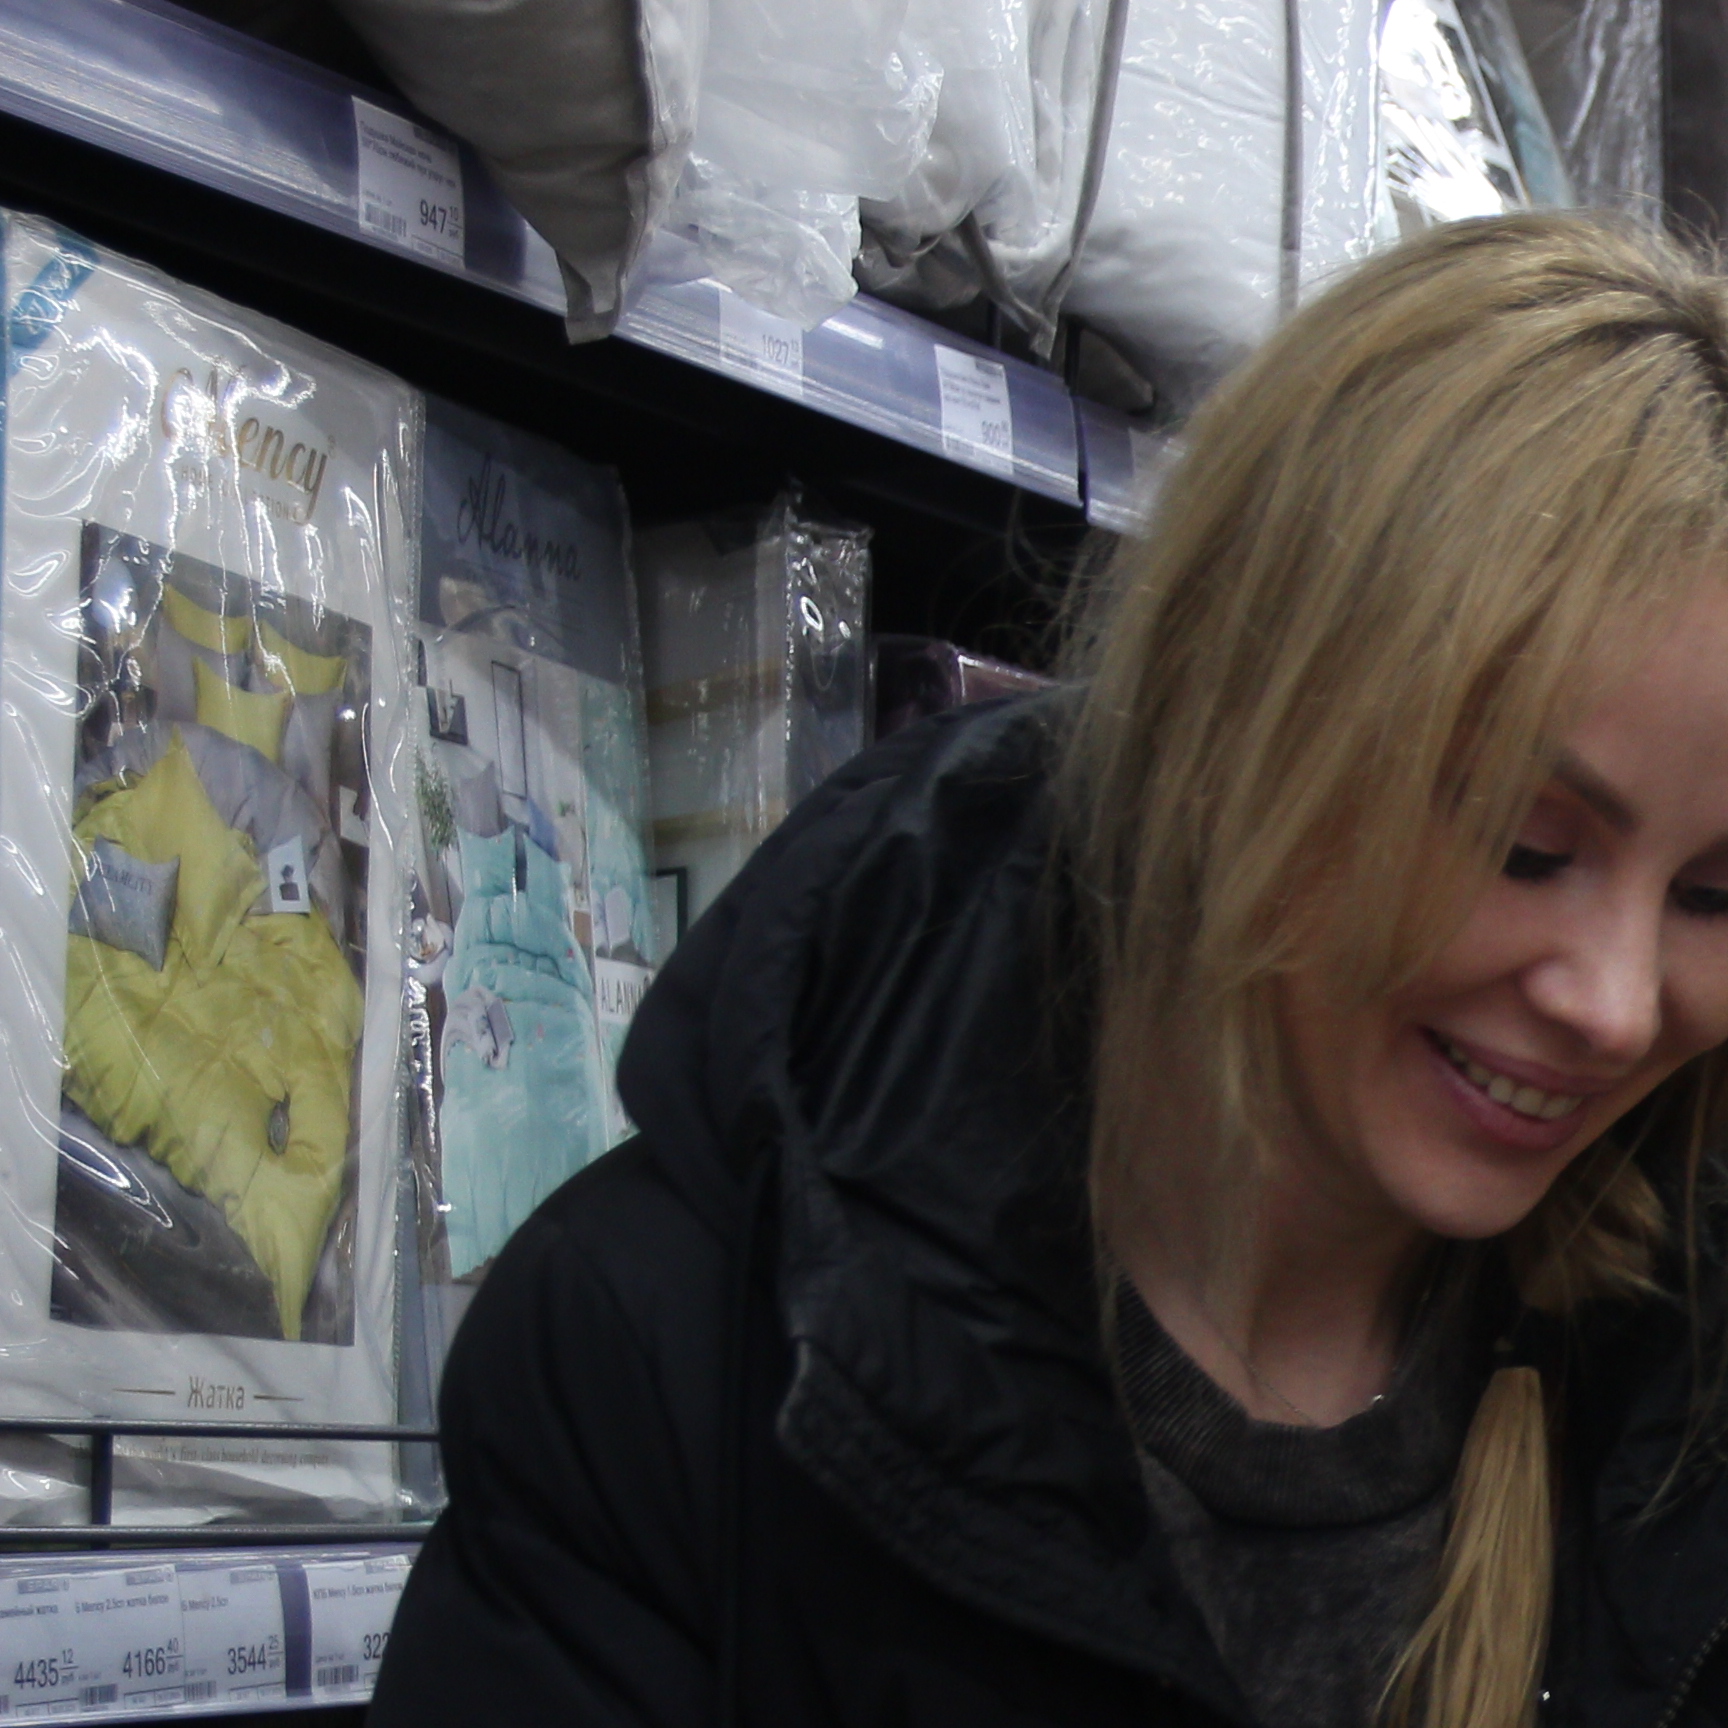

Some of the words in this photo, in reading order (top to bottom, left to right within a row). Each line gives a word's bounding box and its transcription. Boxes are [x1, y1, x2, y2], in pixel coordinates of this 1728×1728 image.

[420, 199, 447, 234] 947
[762, 334, 789, 365] 1027
[187, 1375, 246, 1411] Жатка
[14, 1658, 59, 1690] 4435
[62, 1648, 74, 1665] 12
[123, 1646, 166, 1679] 4166
[227, 1643, 267, 1676] 3544
